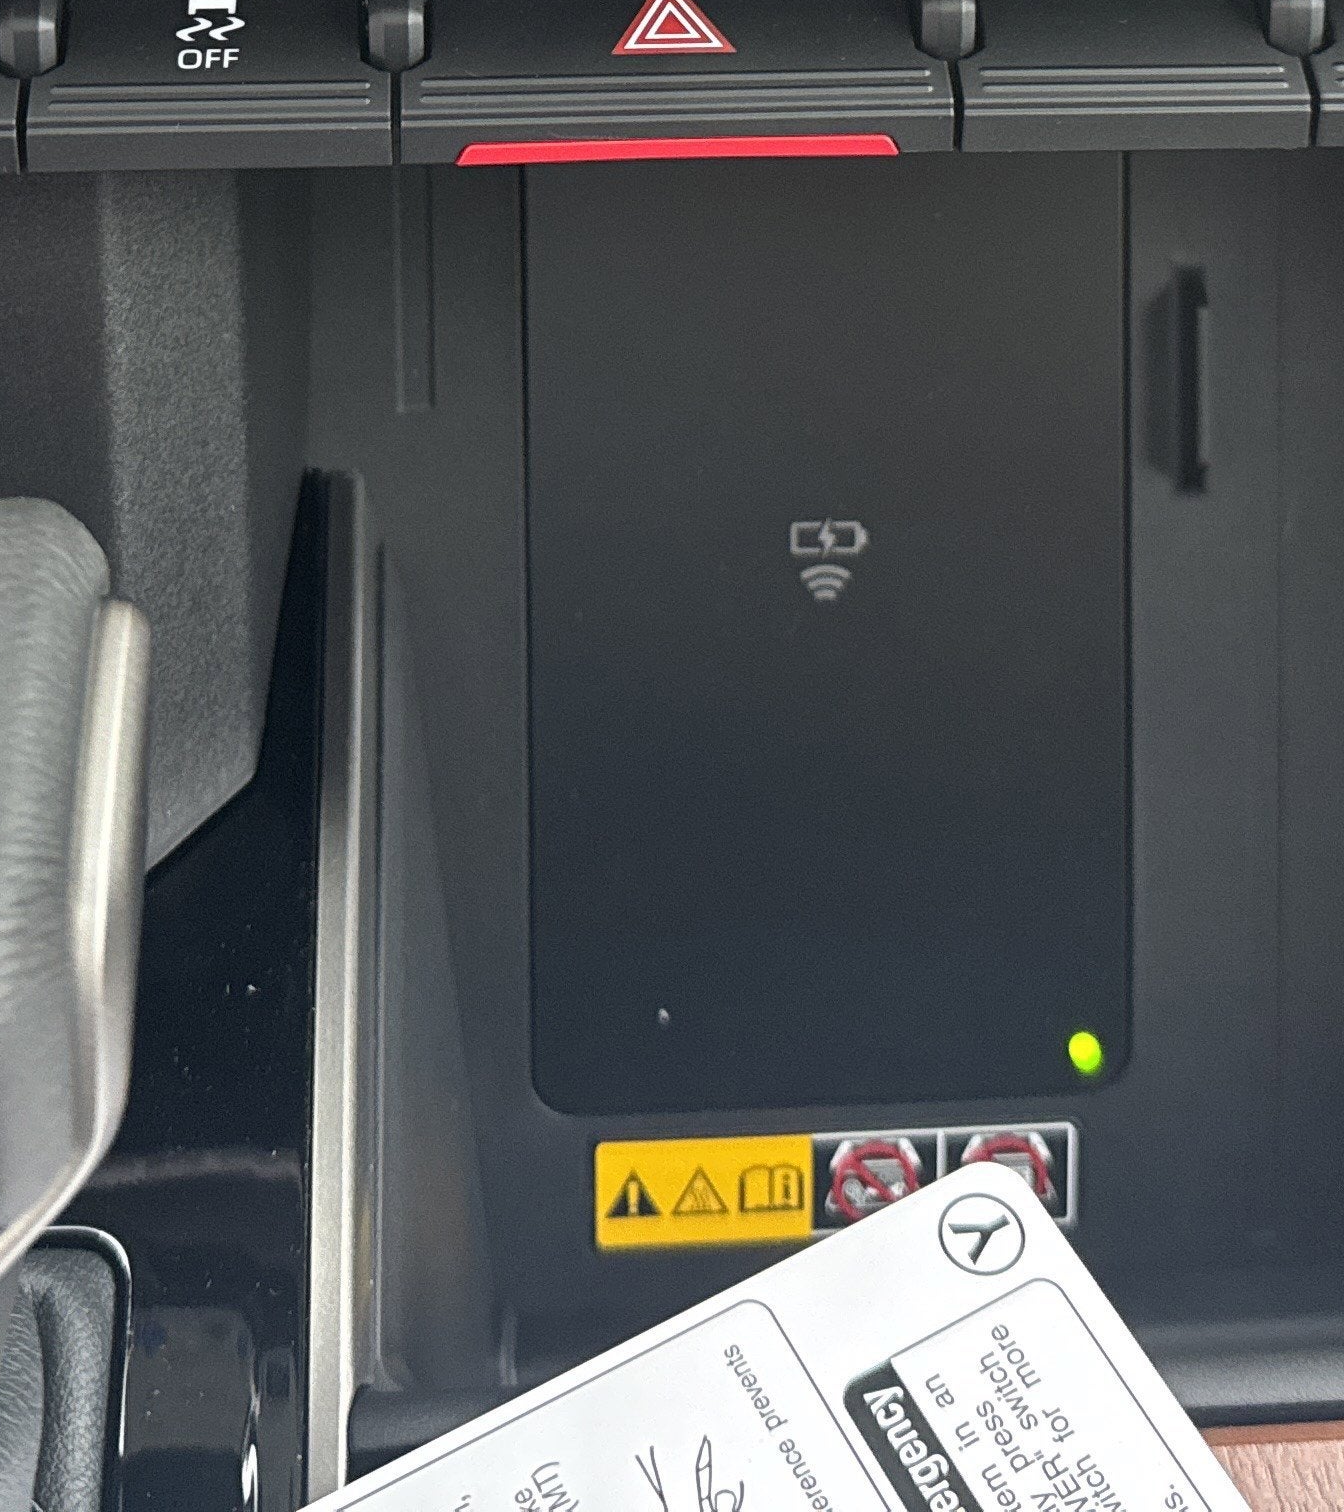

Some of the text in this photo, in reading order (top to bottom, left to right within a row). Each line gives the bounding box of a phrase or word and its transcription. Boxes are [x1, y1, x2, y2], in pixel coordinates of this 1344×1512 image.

[175, 48, 241, 70] OFF
[724, 1343, 787, 1432] prevents
[990, 1323, 1041, 1389] more
[925, 1372, 955, 1409] an
[979, 1351, 1039, 1431] switch
[863, 1385, 966, 1512] ergency
[955, 1420, 980, 1452] in
[975, 1400, 1037, 1474] press
[1042, 1406, 1076, 1444] for
